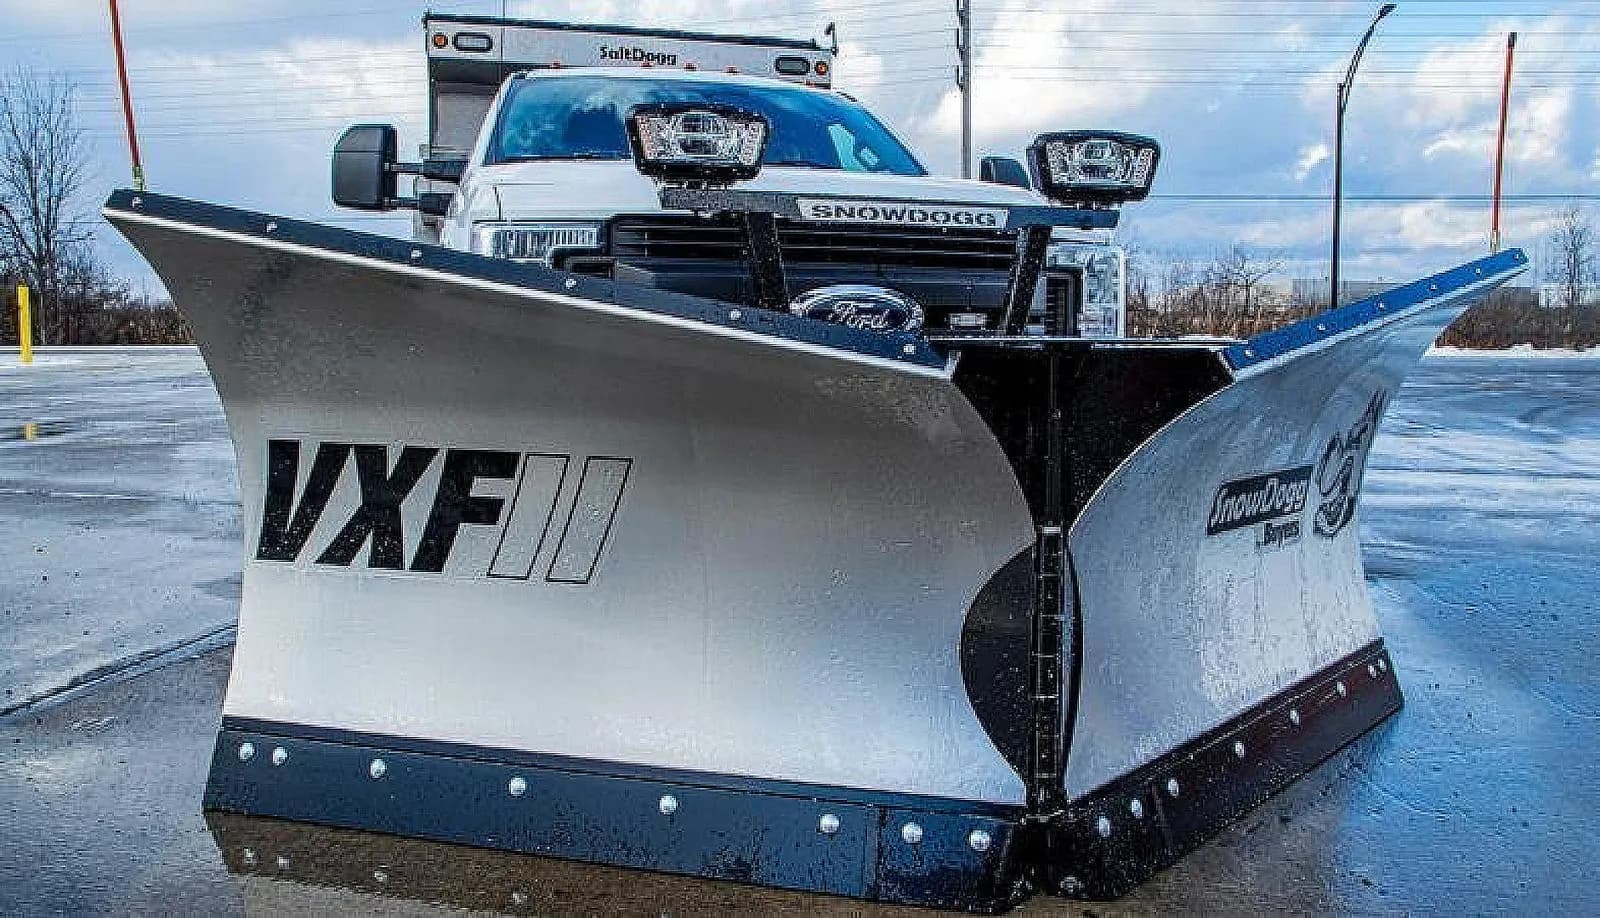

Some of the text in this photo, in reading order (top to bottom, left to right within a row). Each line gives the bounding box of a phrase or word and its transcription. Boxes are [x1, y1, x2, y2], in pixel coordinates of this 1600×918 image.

[600, 46, 677, 66] SaltDogg
[811, 205, 996, 226] SNOWDOGG
[827, 300, 890, 330] Ford
[1210, 476, 1309, 527] SnowDogg
